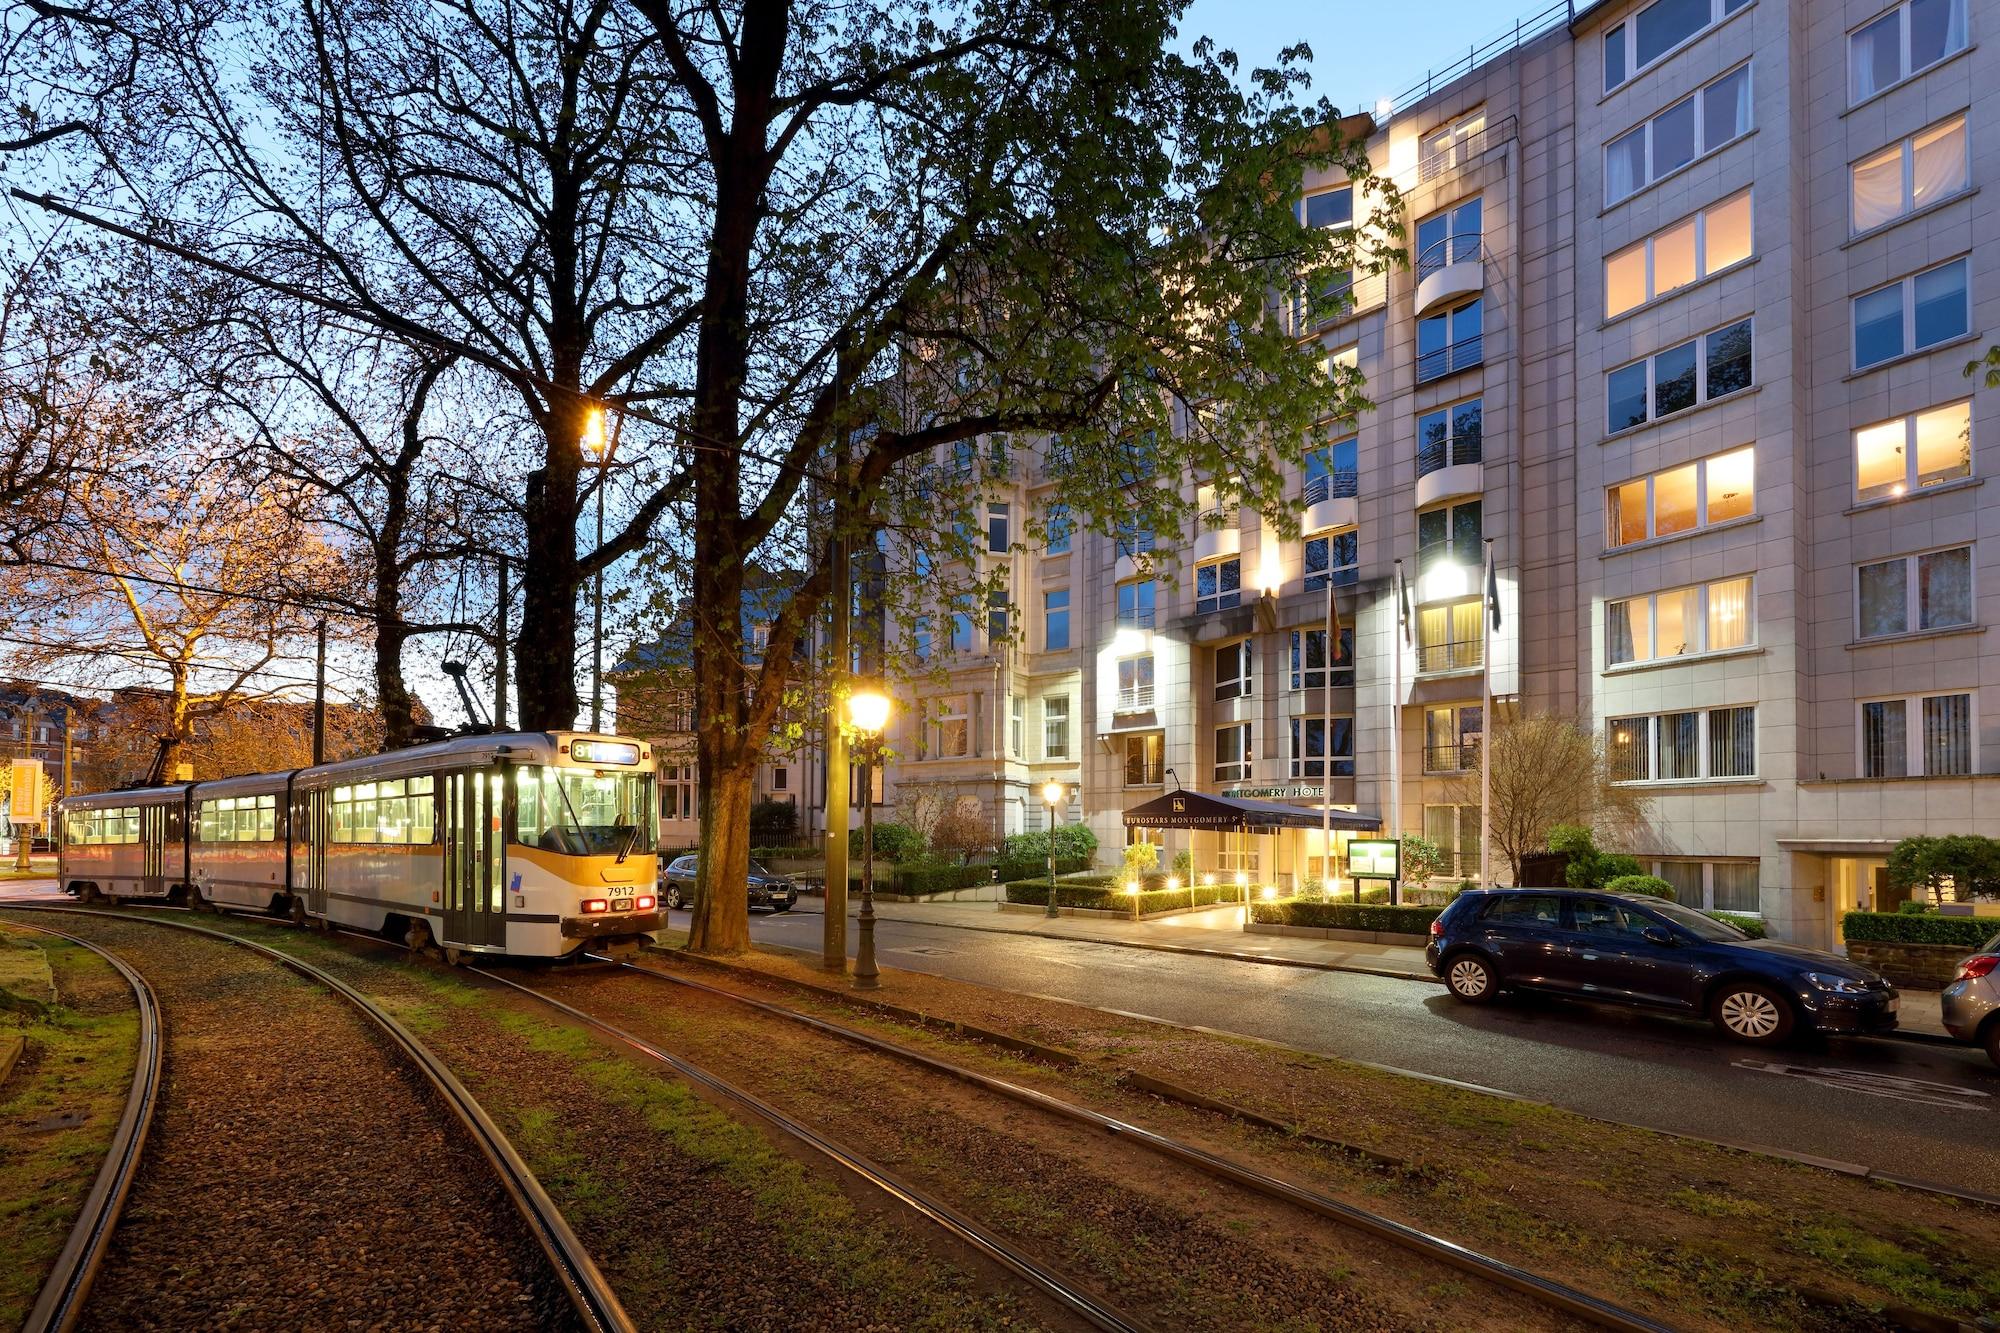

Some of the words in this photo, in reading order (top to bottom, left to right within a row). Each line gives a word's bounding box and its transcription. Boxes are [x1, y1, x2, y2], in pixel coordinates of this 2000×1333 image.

[574, 744, 593, 759] 81
[1293, 787, 1325, 797] HOTE
[1126, 816, 1169, 824] EUROSTARS
[1170, 815, 1228, 824] MONTGOMERY
[607, 886, 634, 897] 7912
